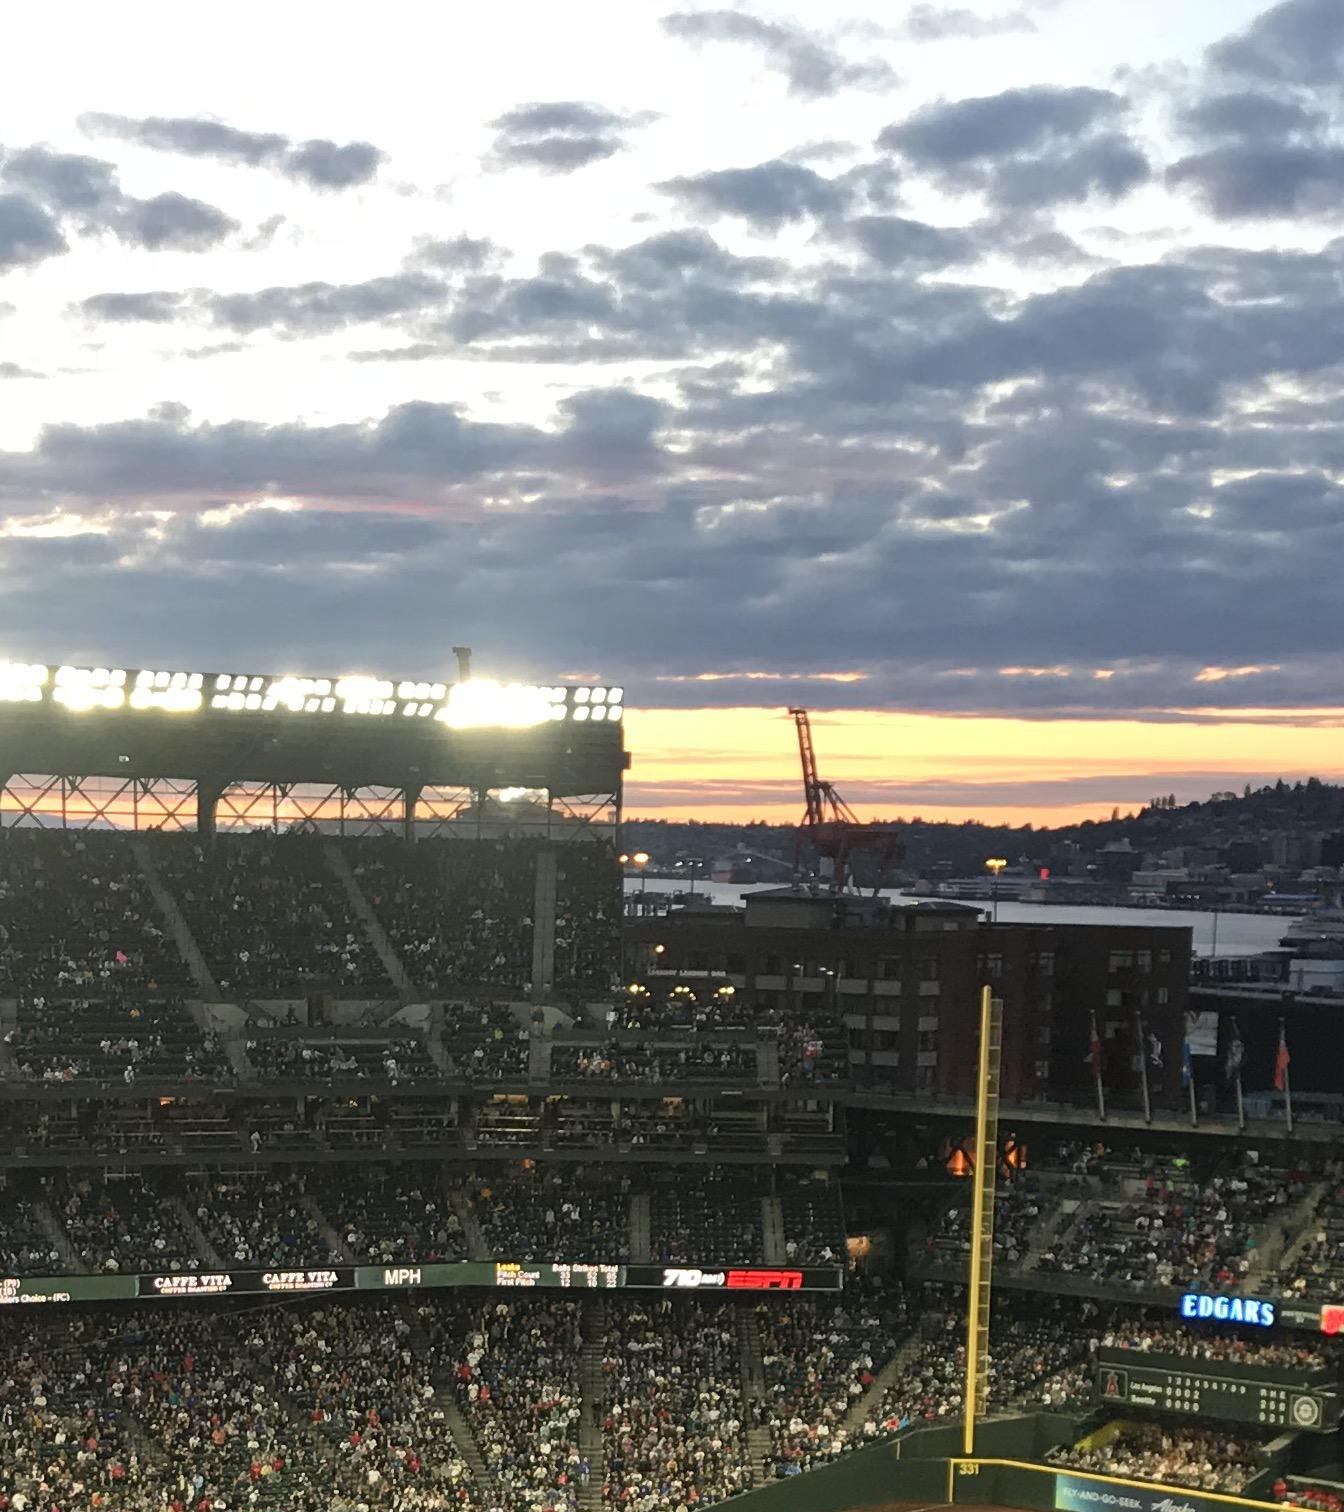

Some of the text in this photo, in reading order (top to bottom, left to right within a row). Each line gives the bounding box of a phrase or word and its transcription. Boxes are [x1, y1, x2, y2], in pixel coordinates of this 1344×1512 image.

[154, 1274, 232, 1288] CAFFE VITA
[262, 1271, 338, 1284] CAFFE VITA
[384, 1269, 421, 1285] MPH
[663, 1269, 702, 1287] 710
[726, 1270, 803, 1288] ESPN
[1182, 1294, 1274, 1326] EDGAR'S
[959, 1463, 980, 1475] 331
